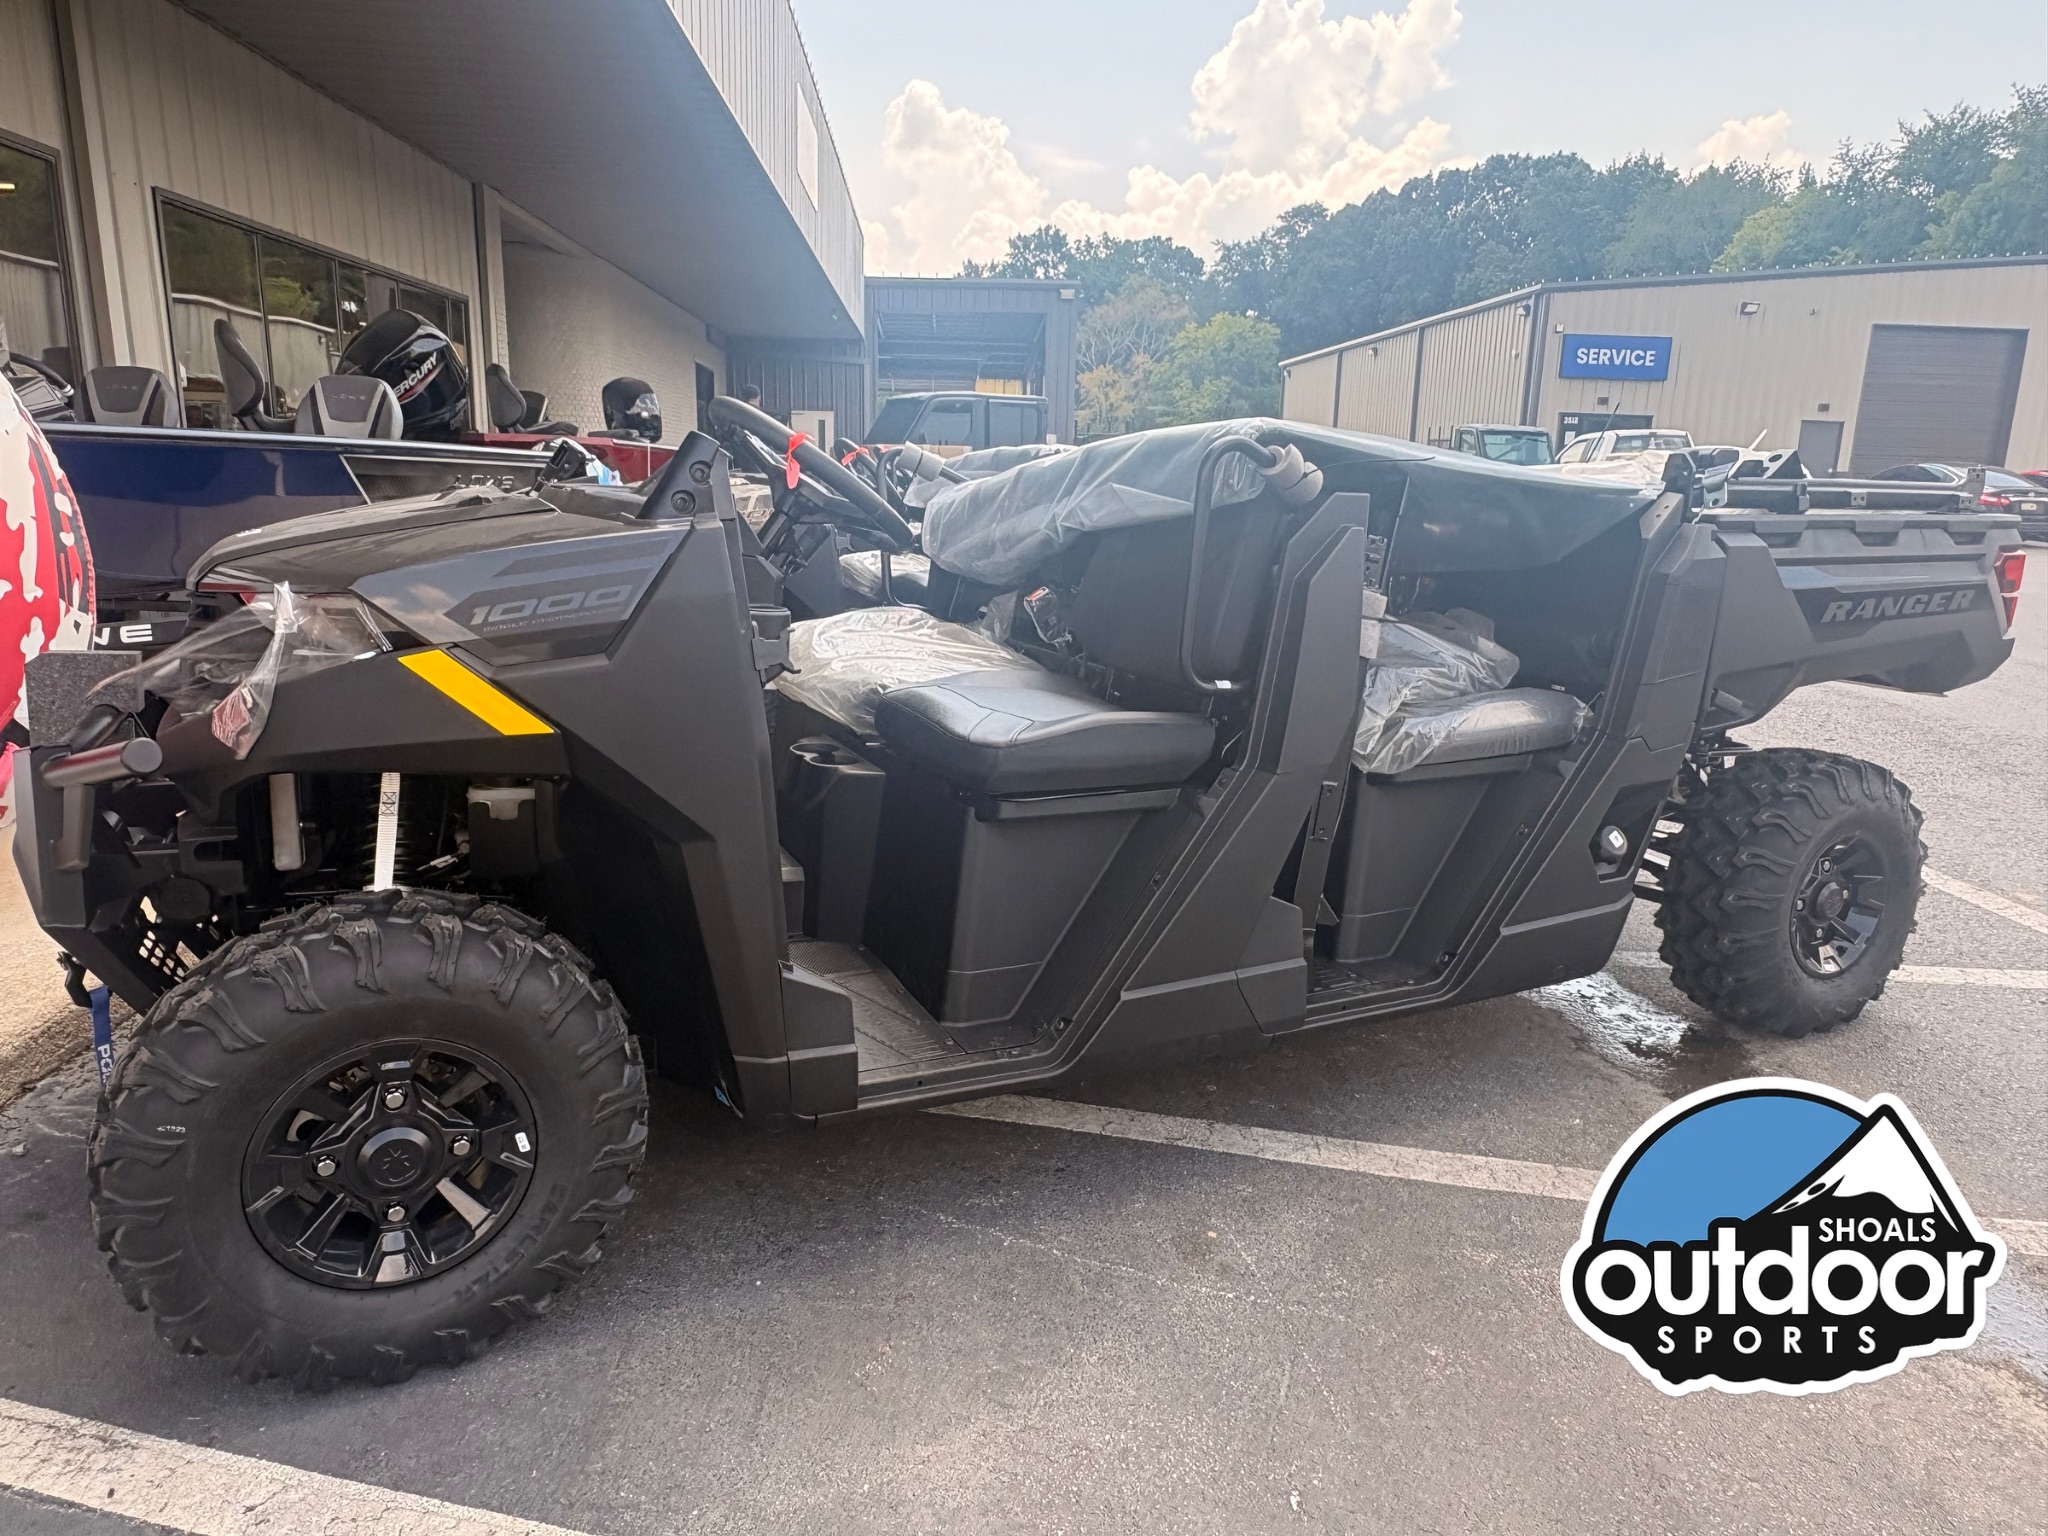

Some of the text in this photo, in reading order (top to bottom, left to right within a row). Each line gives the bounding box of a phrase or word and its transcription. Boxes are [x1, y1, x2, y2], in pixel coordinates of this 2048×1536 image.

[393, 351, 438, 398] ERCURY
[1576, 347, 1656, 367] SERVICE
[470, 584, 633, 626] 1000
[1820, 589, 1976, 623] RANGER
